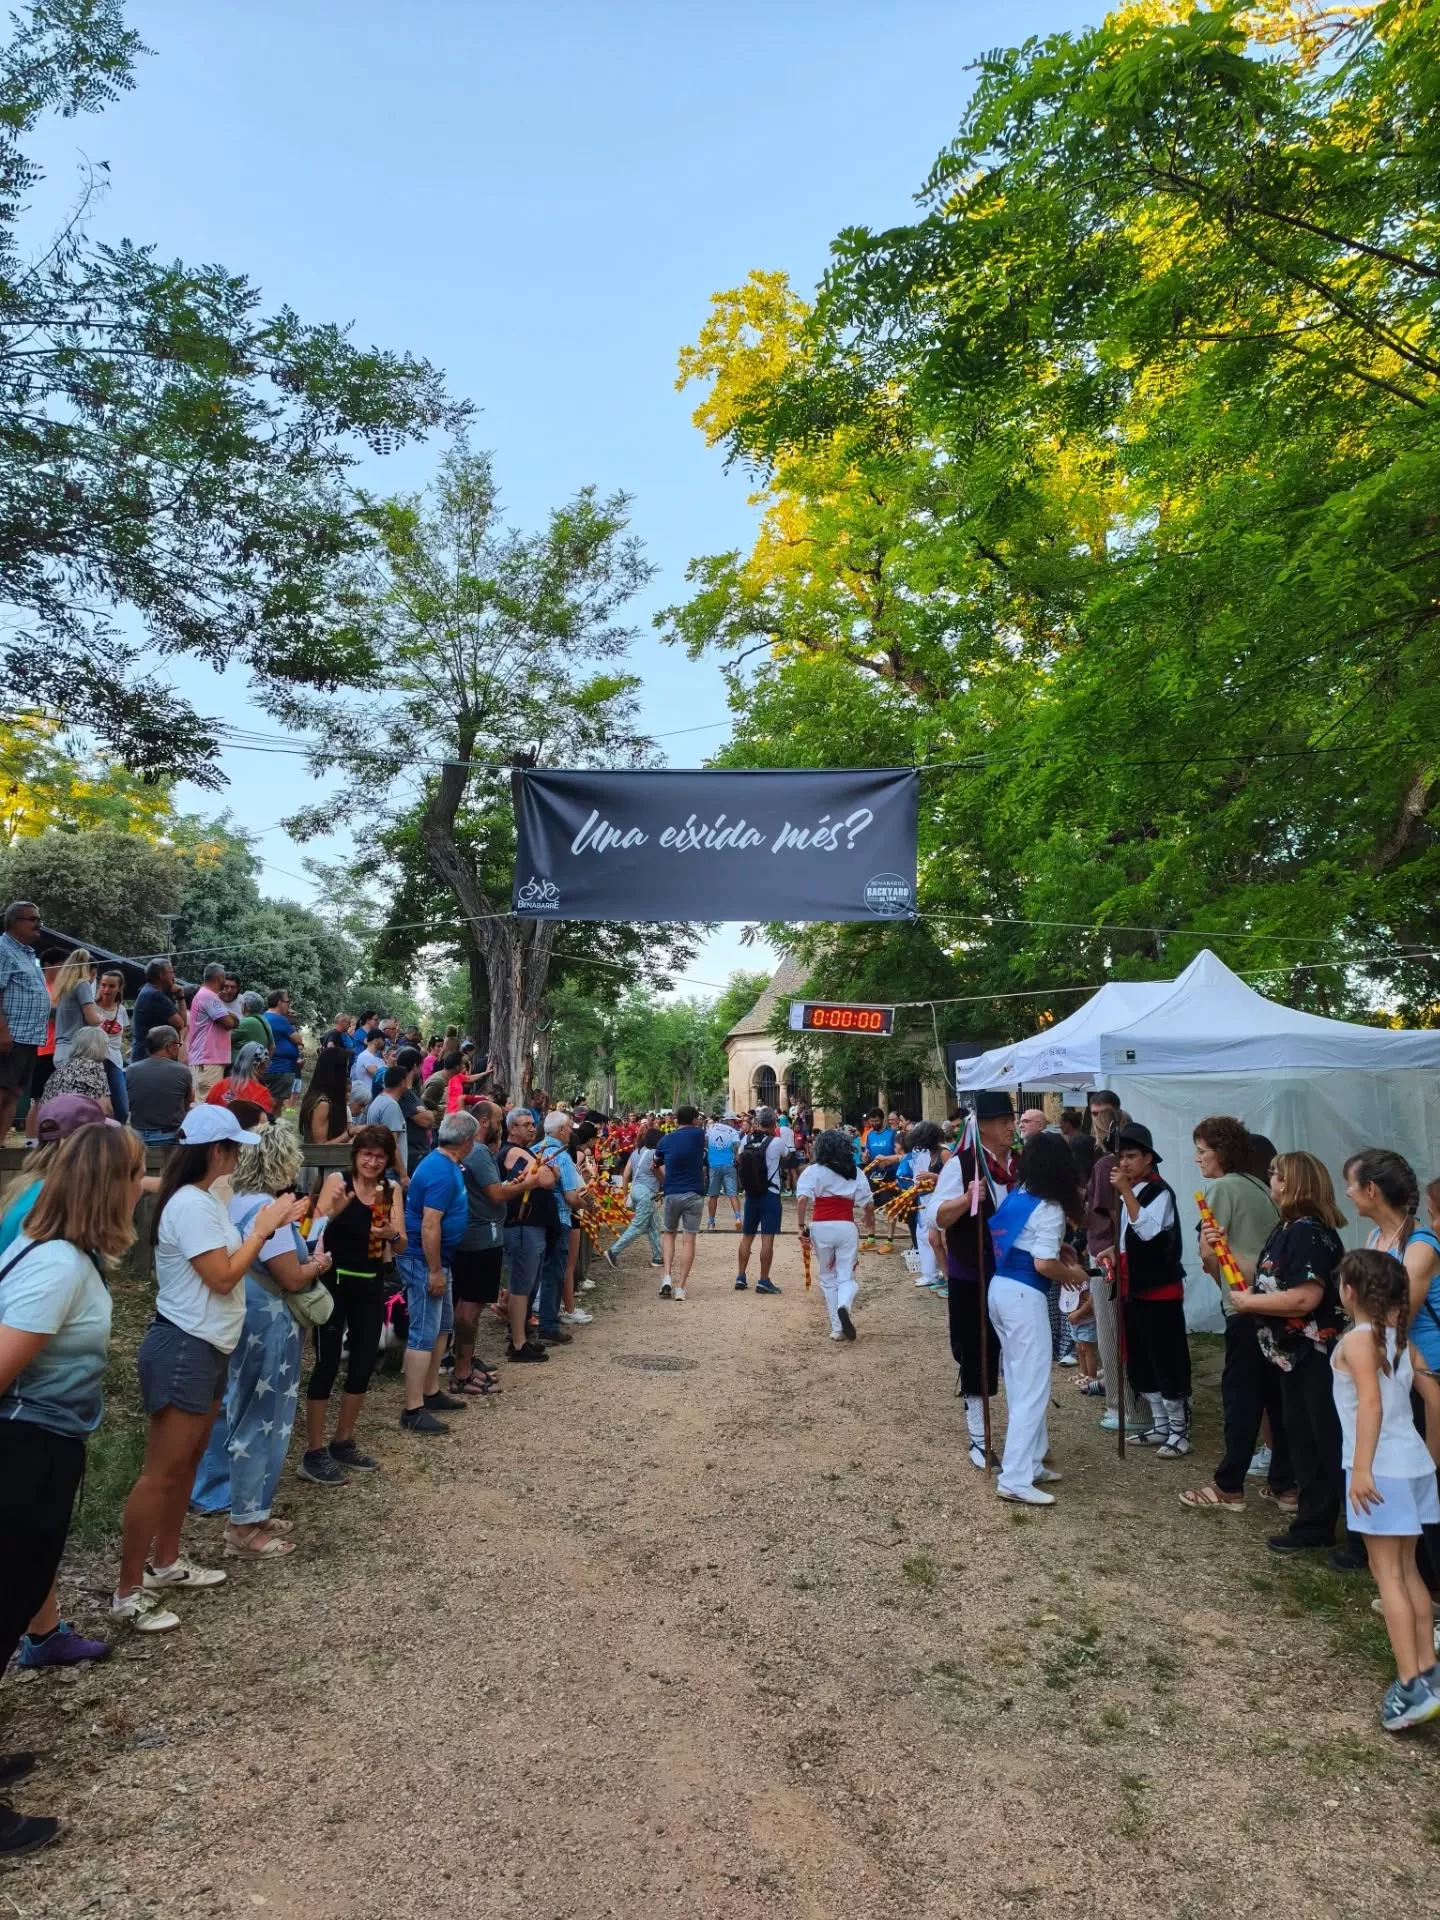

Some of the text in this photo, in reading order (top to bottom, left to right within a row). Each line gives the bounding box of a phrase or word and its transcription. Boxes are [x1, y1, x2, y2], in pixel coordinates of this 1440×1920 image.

[571, 808, 874, 855] Una eixida més?
[866, 887, 909, 897] BACKYARD
[517, 899, 560, 910] BENABARRE
[813, 1008, 882, 1030] 0:00:00
